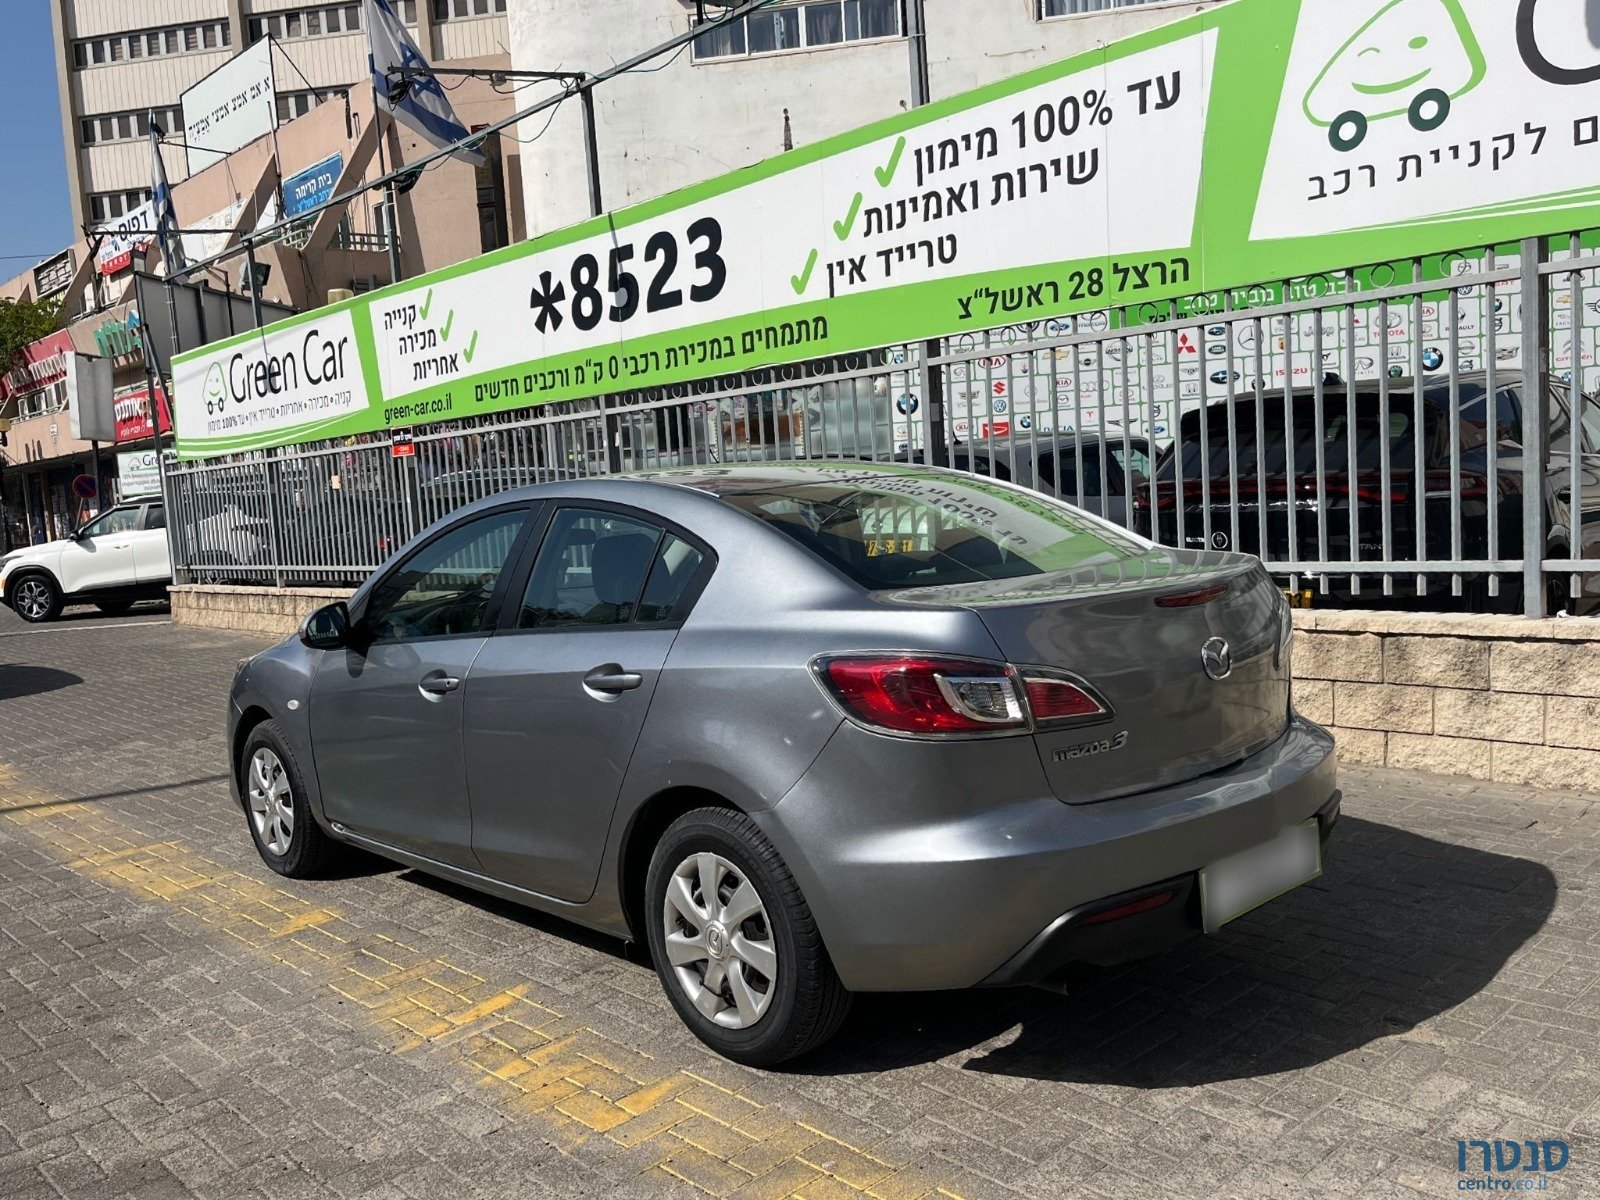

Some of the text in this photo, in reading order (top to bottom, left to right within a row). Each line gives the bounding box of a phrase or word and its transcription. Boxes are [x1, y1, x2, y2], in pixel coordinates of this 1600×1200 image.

[914, 70, 1181, 187] עד 100% מימון
[1396, 121, 1547, 182] לקניית
[318, 173, 333, 189] בית
[863, 147, 1099, 239] שירות ואמינות
[1307, 163, 1377, 201] רכב
[118, 210, 149, 242] דפוס
[825, 232, 957, 299] טרייד אין
[1112, 256, 1190, 293] הרצל
[1069, 266, 1104, 300] 28
[384, 304, 417, 330] קנייה
[399, 328, 437, 355] מכירה
[741, 314, 828, 355] מתמחים
[1373, 329, 1405, 338] TOTA
[622, 350, 660, 376] רכבי
[665, 334, 736, 369] במכירת
[1106, 346, 1133, 355] NISSN
[229, 329, 348, 404] Green Car
[413, 353, 459, 381] אחריות
[523, 366, 570, 396] ורכבים
[608, 356, 619, 380] 0
[1276, 367, 1308, 377] ISZU
[474, 376, 519, 402] חדשים
[384, 392, 453, 425] green-car.co.il
[142, 454, 160, 467] Gre
